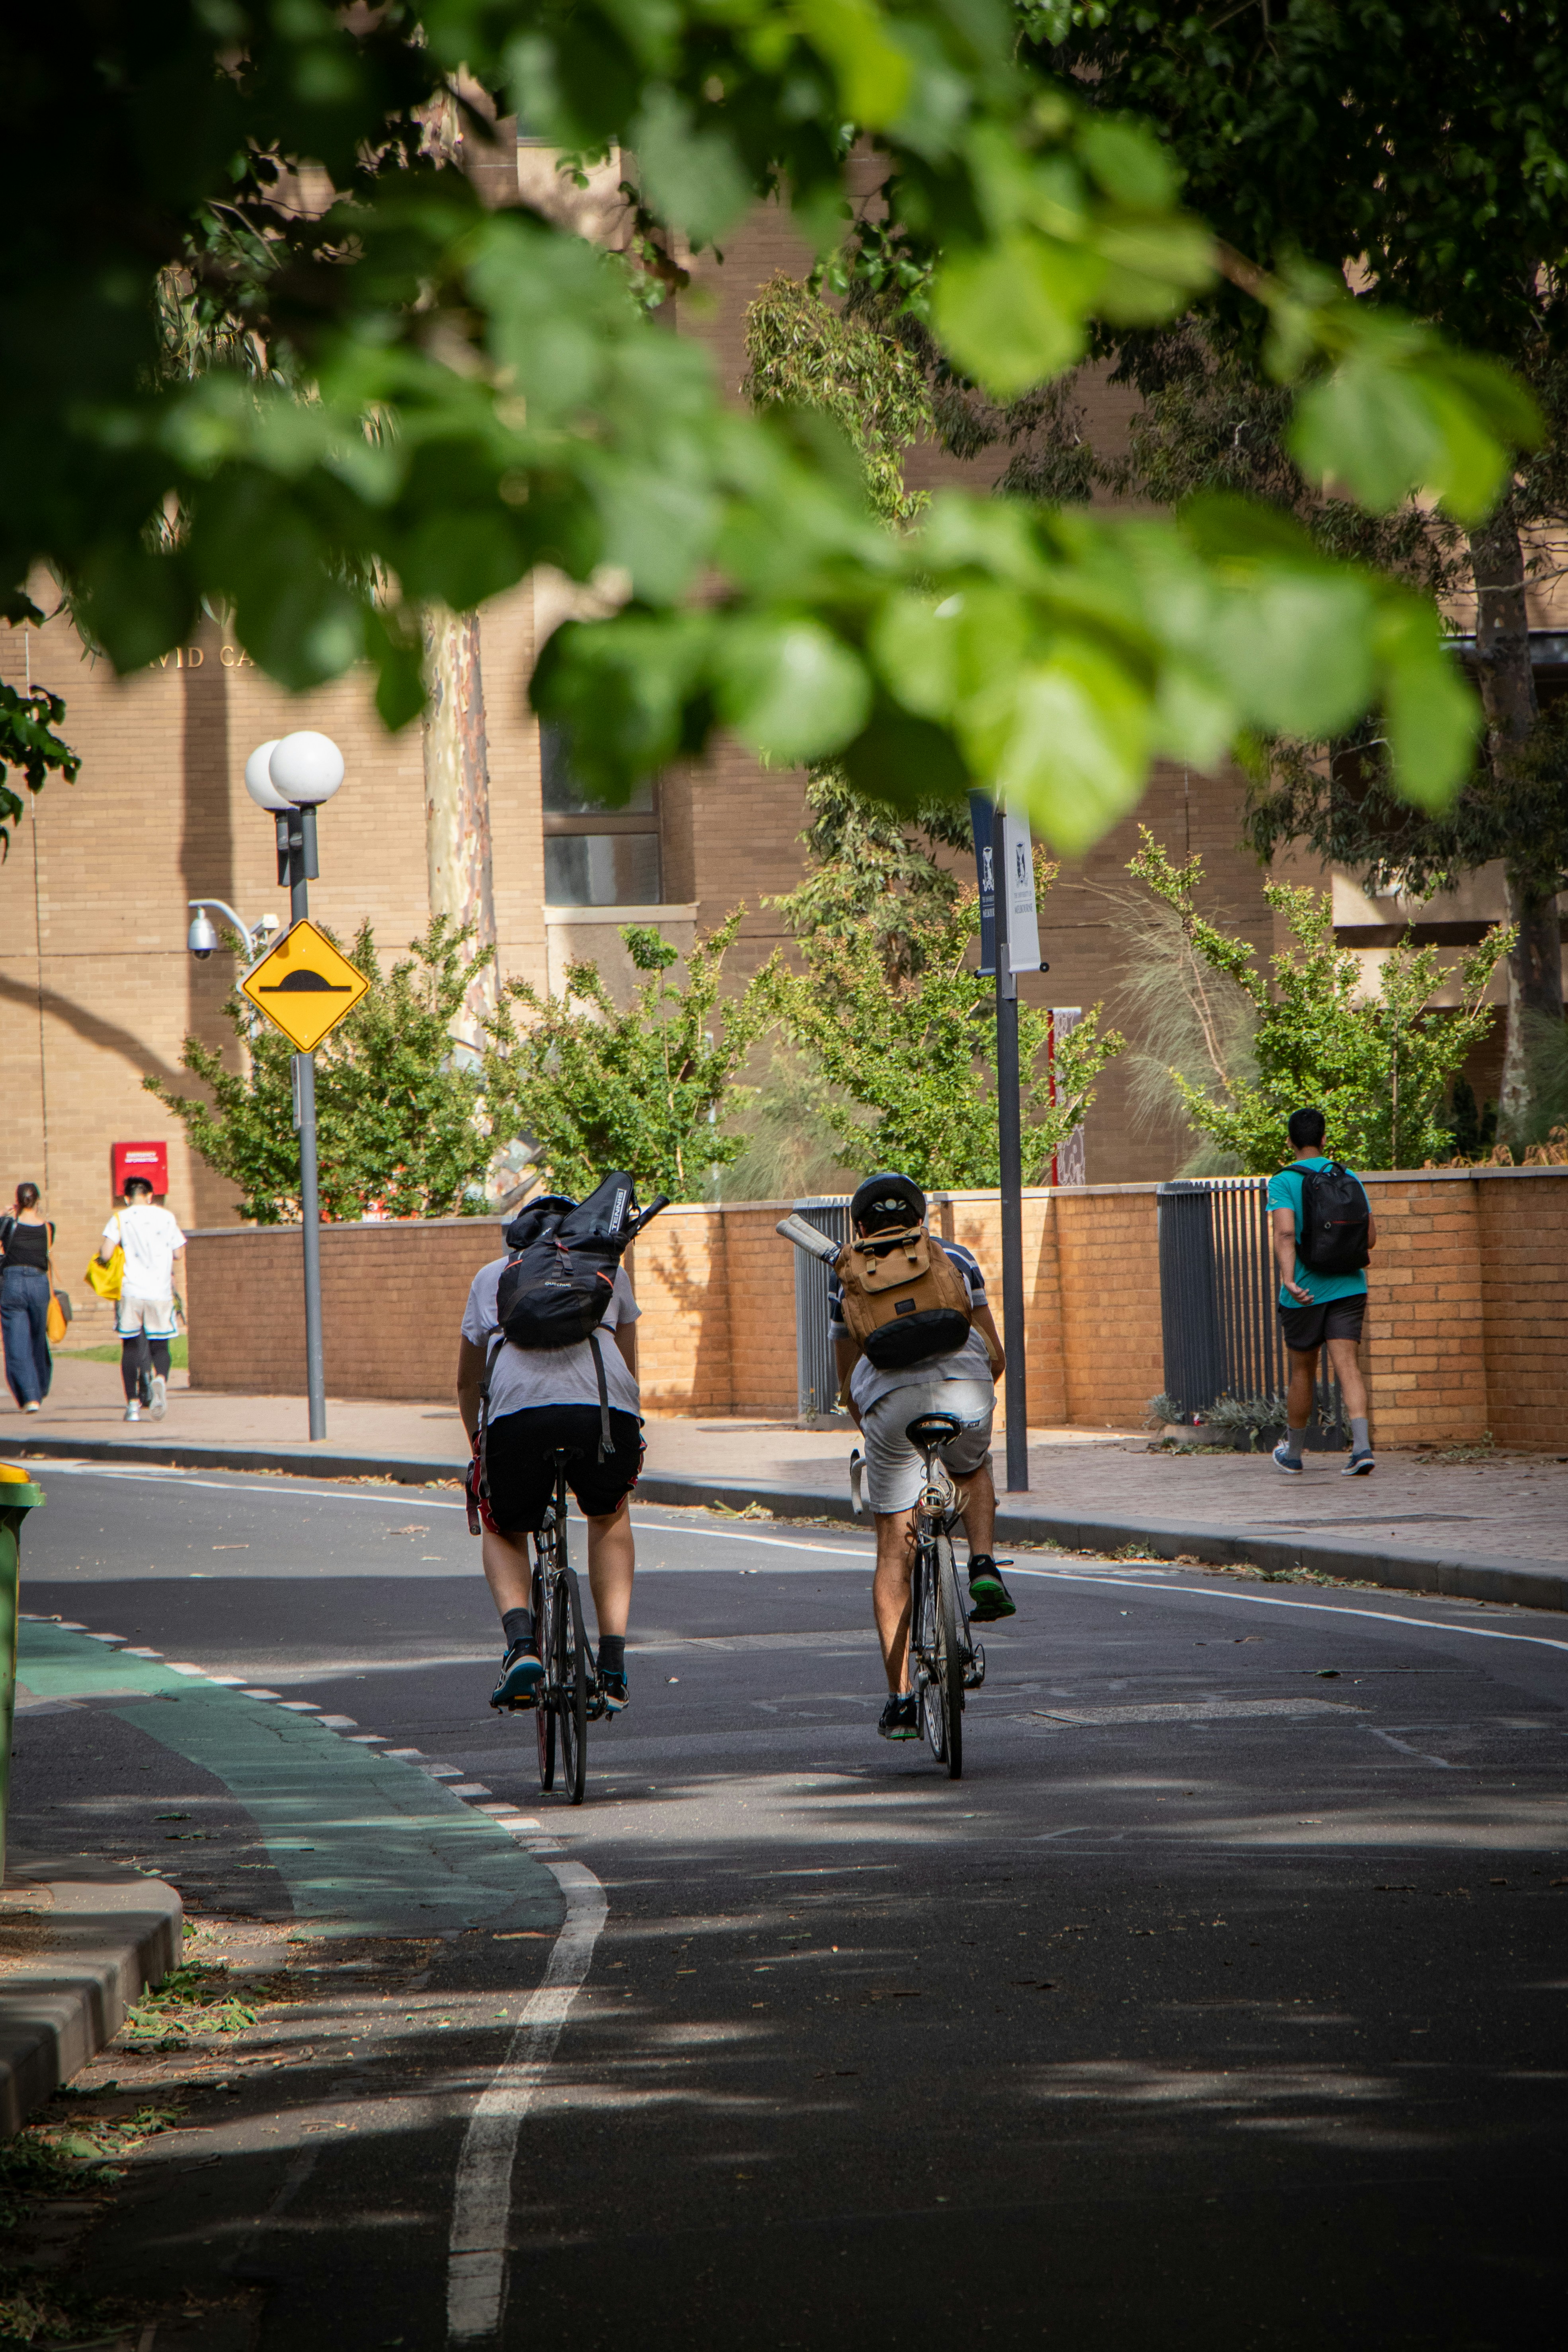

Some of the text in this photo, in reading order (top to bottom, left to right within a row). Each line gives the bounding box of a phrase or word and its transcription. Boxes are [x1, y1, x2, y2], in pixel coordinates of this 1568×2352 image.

[149, 645, 255, 668] VID CA
[1014, 903, 1033, 914] MELBOURNE
[612, 1191, 624, 1231] TENNIS
